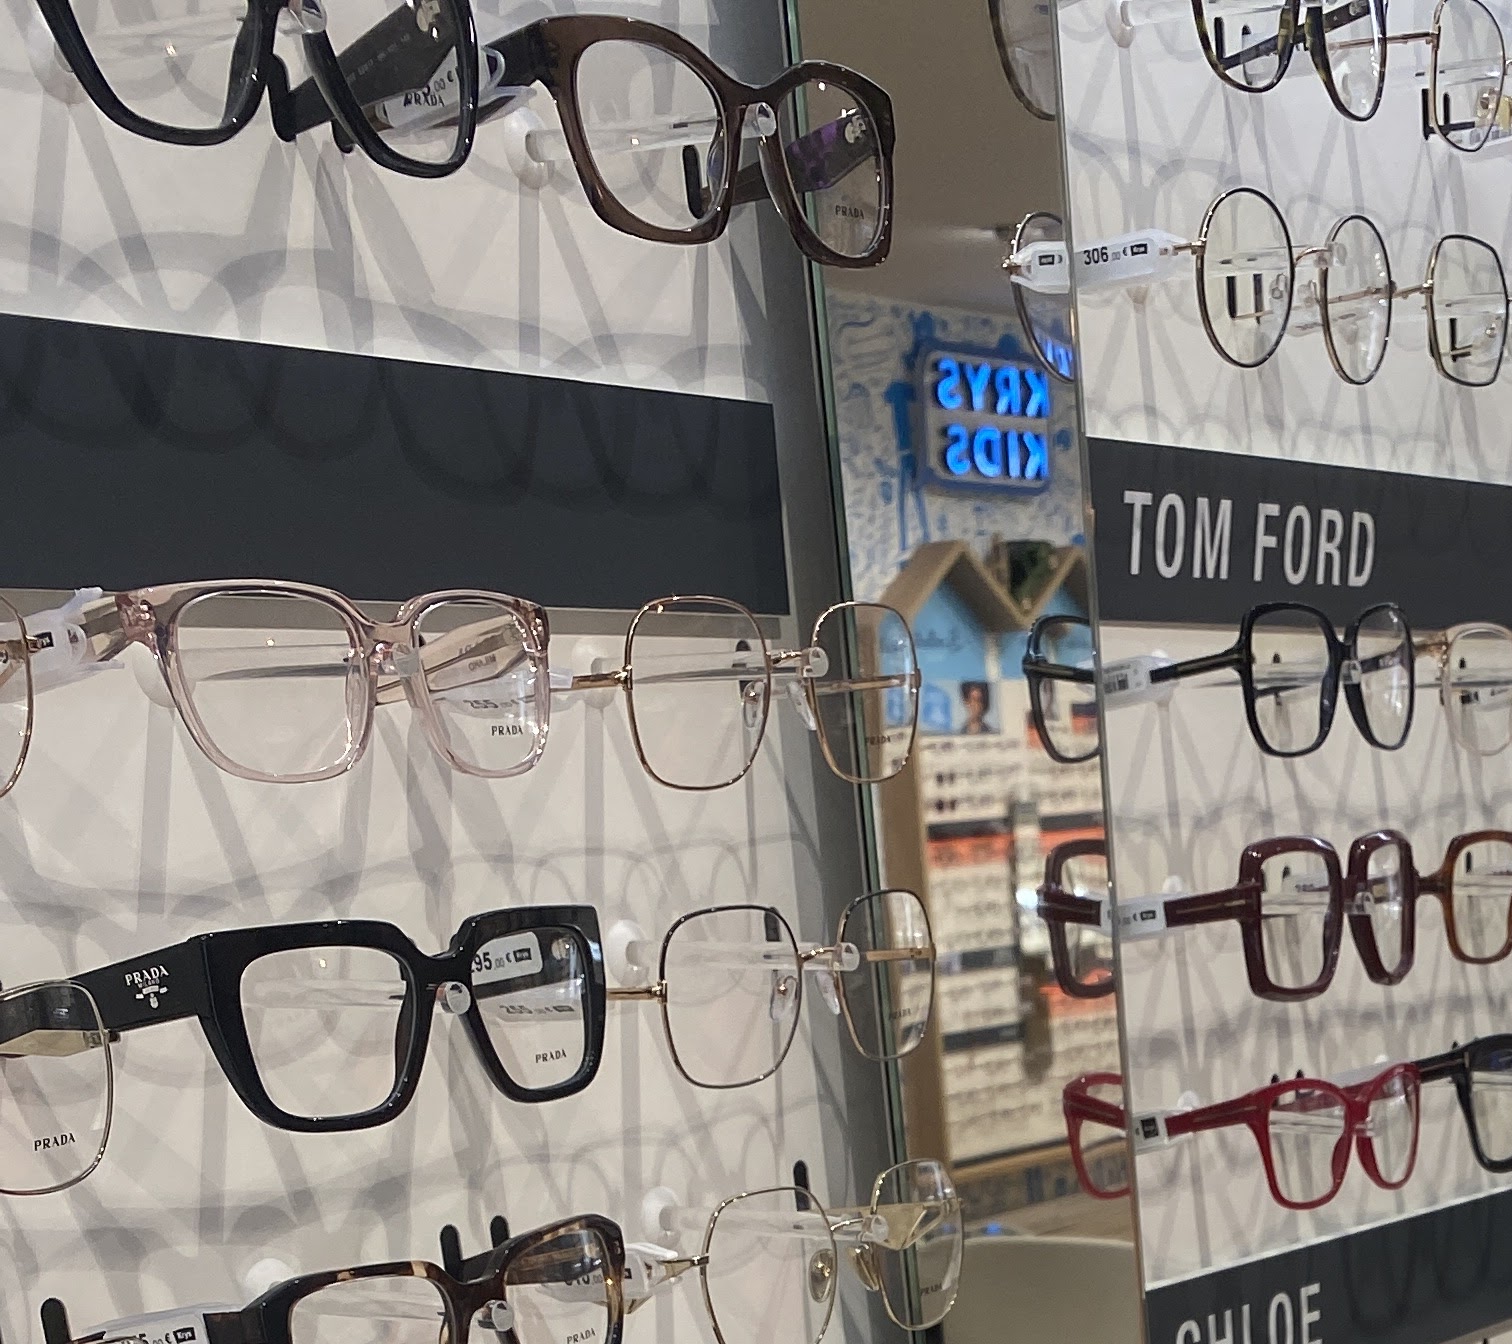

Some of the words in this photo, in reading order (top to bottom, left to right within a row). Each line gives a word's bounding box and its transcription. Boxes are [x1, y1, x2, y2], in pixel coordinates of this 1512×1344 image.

[1123, 490, 1231, 580] TOM
[1253, 502, 1375, 588] FORD
[491, 725, 524, 737] PRADA
[125, 966, 169, 986] PRADA
[535, 1049, 567, 1063] PRADA
[33, 1132, 76, 1151] PRADA
